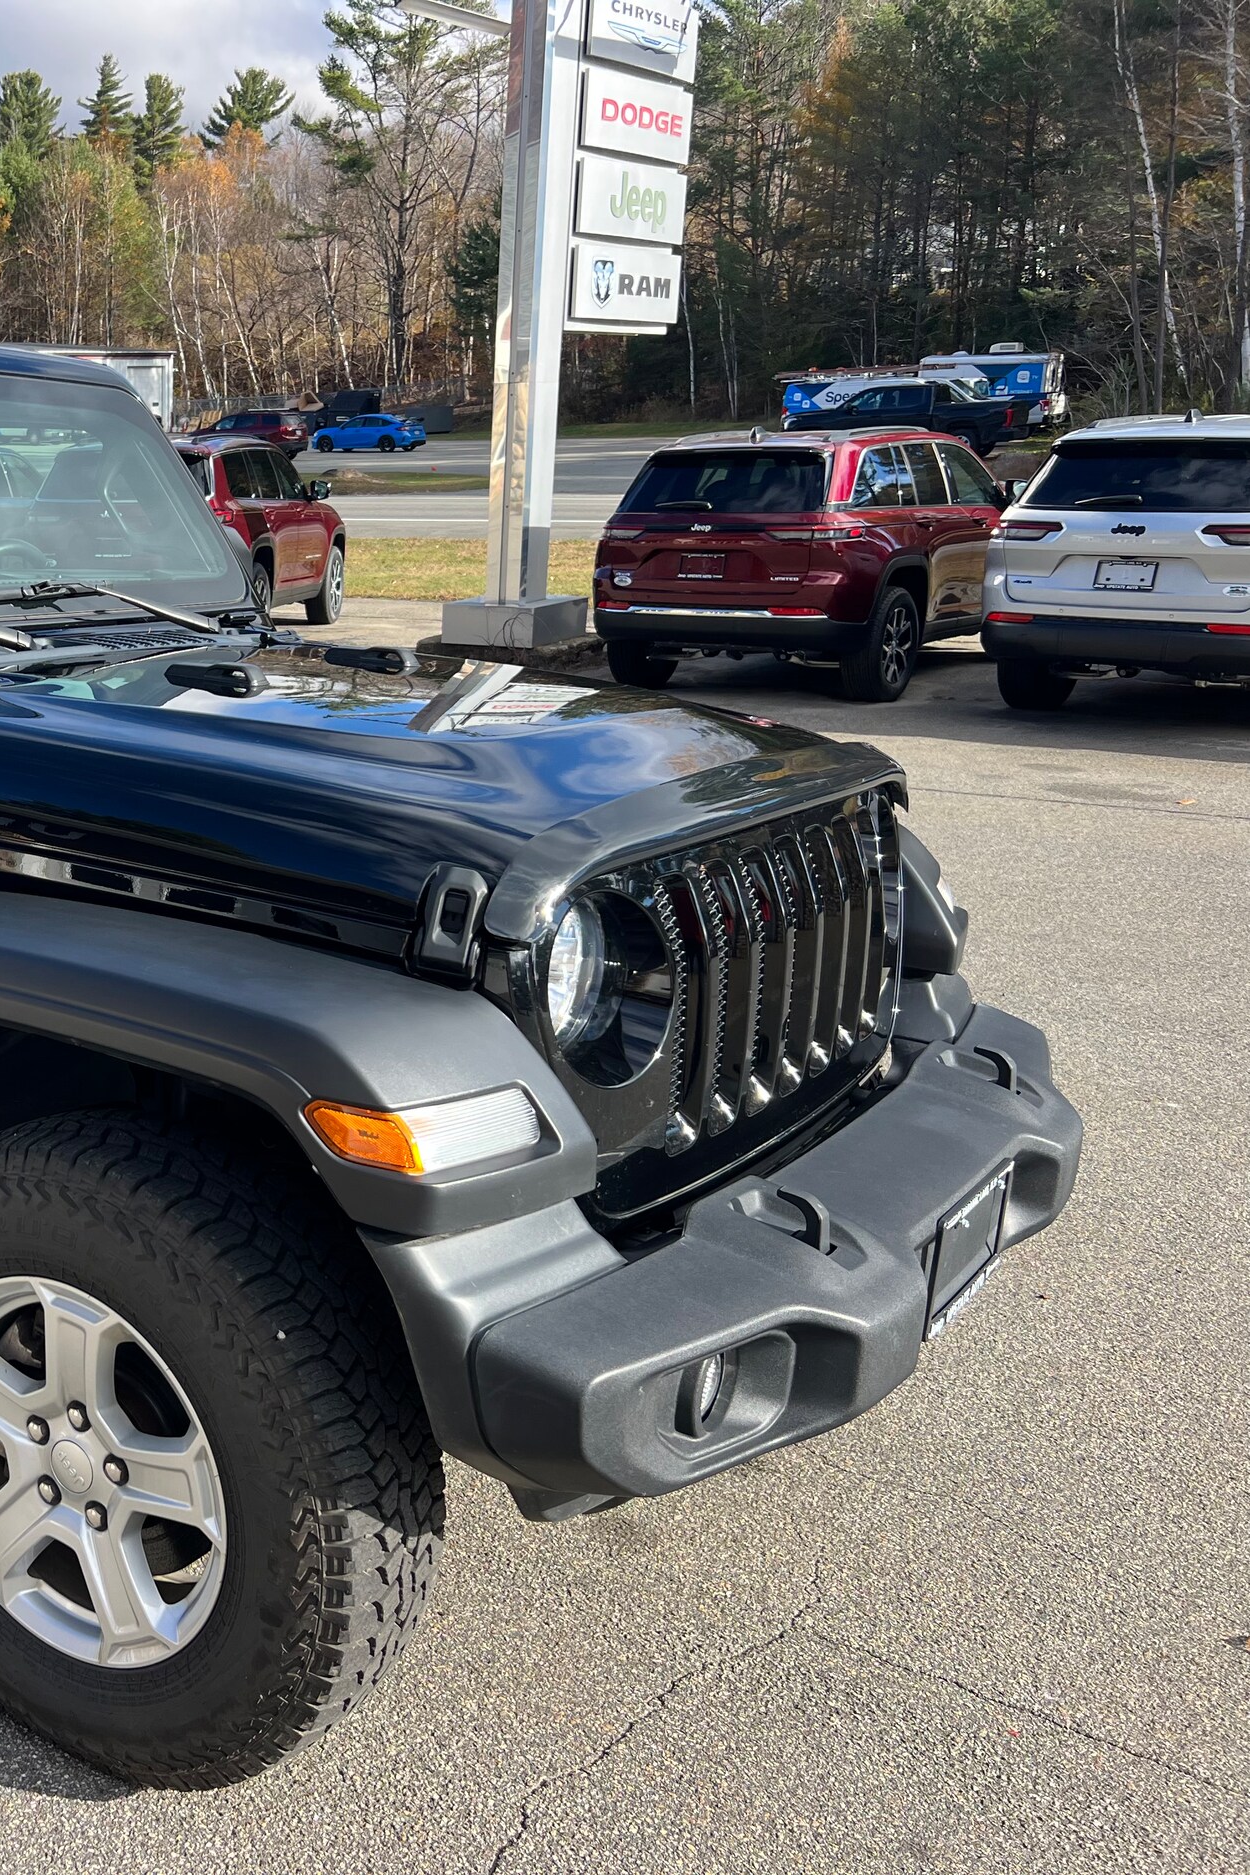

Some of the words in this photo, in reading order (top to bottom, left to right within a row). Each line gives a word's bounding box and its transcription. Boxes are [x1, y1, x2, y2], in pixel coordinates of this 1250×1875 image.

[611, 0, 686, 34] CHRYSLER
[601, 98, 683, 137] DODGE
[610, 171, 667, 233] Jeep
[618, 273, 671, 299] RAM
[691, 523, 711, 532] Jeep
[1110, 522, 1146, 537] Jeep
